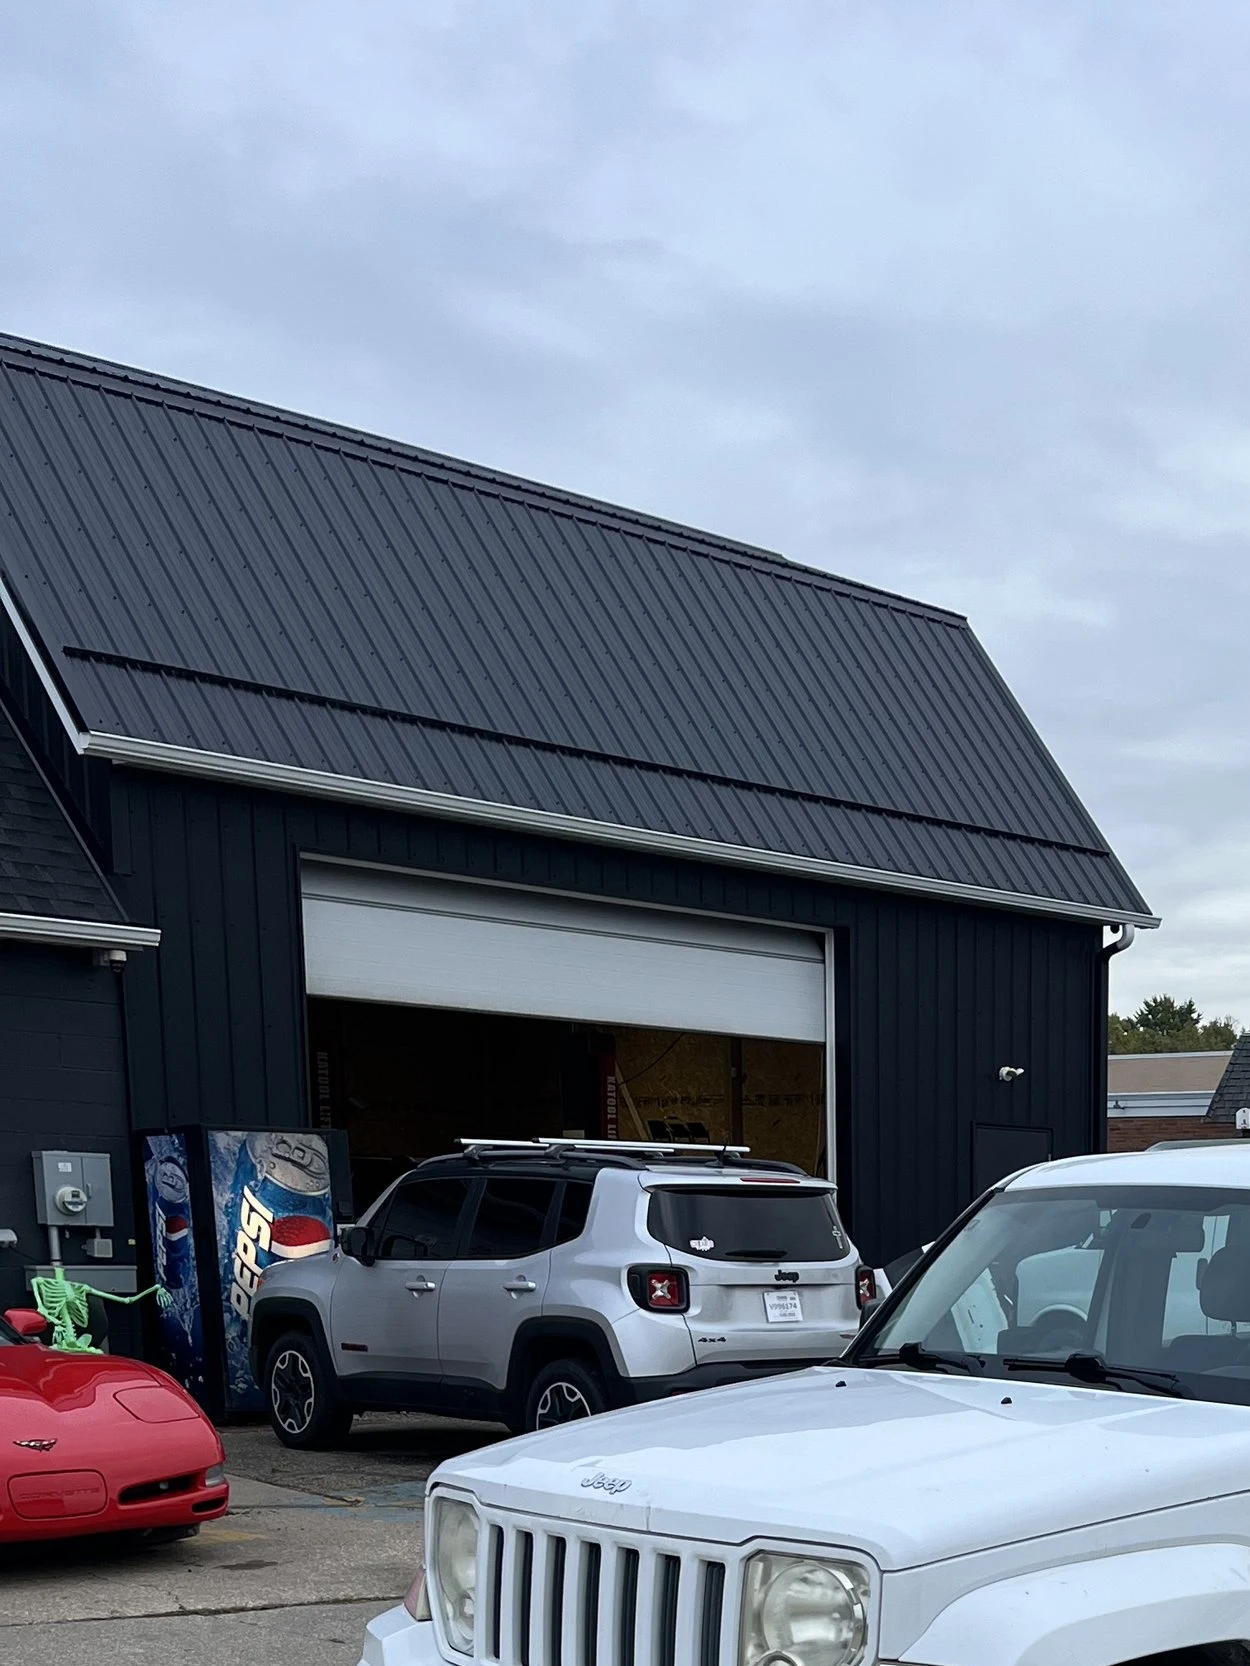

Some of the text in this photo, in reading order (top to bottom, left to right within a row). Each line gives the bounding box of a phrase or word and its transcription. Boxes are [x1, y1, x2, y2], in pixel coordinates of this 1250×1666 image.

[606, 1076, 617, 1120] KATOOL
[155, 1201, 167, 1282] PEPSI
[231, 1185, 275, 1320] PEPSI
[774, 1269, 800, 1283] Jeep
[580, 1471, 632, 1495] Jeep
